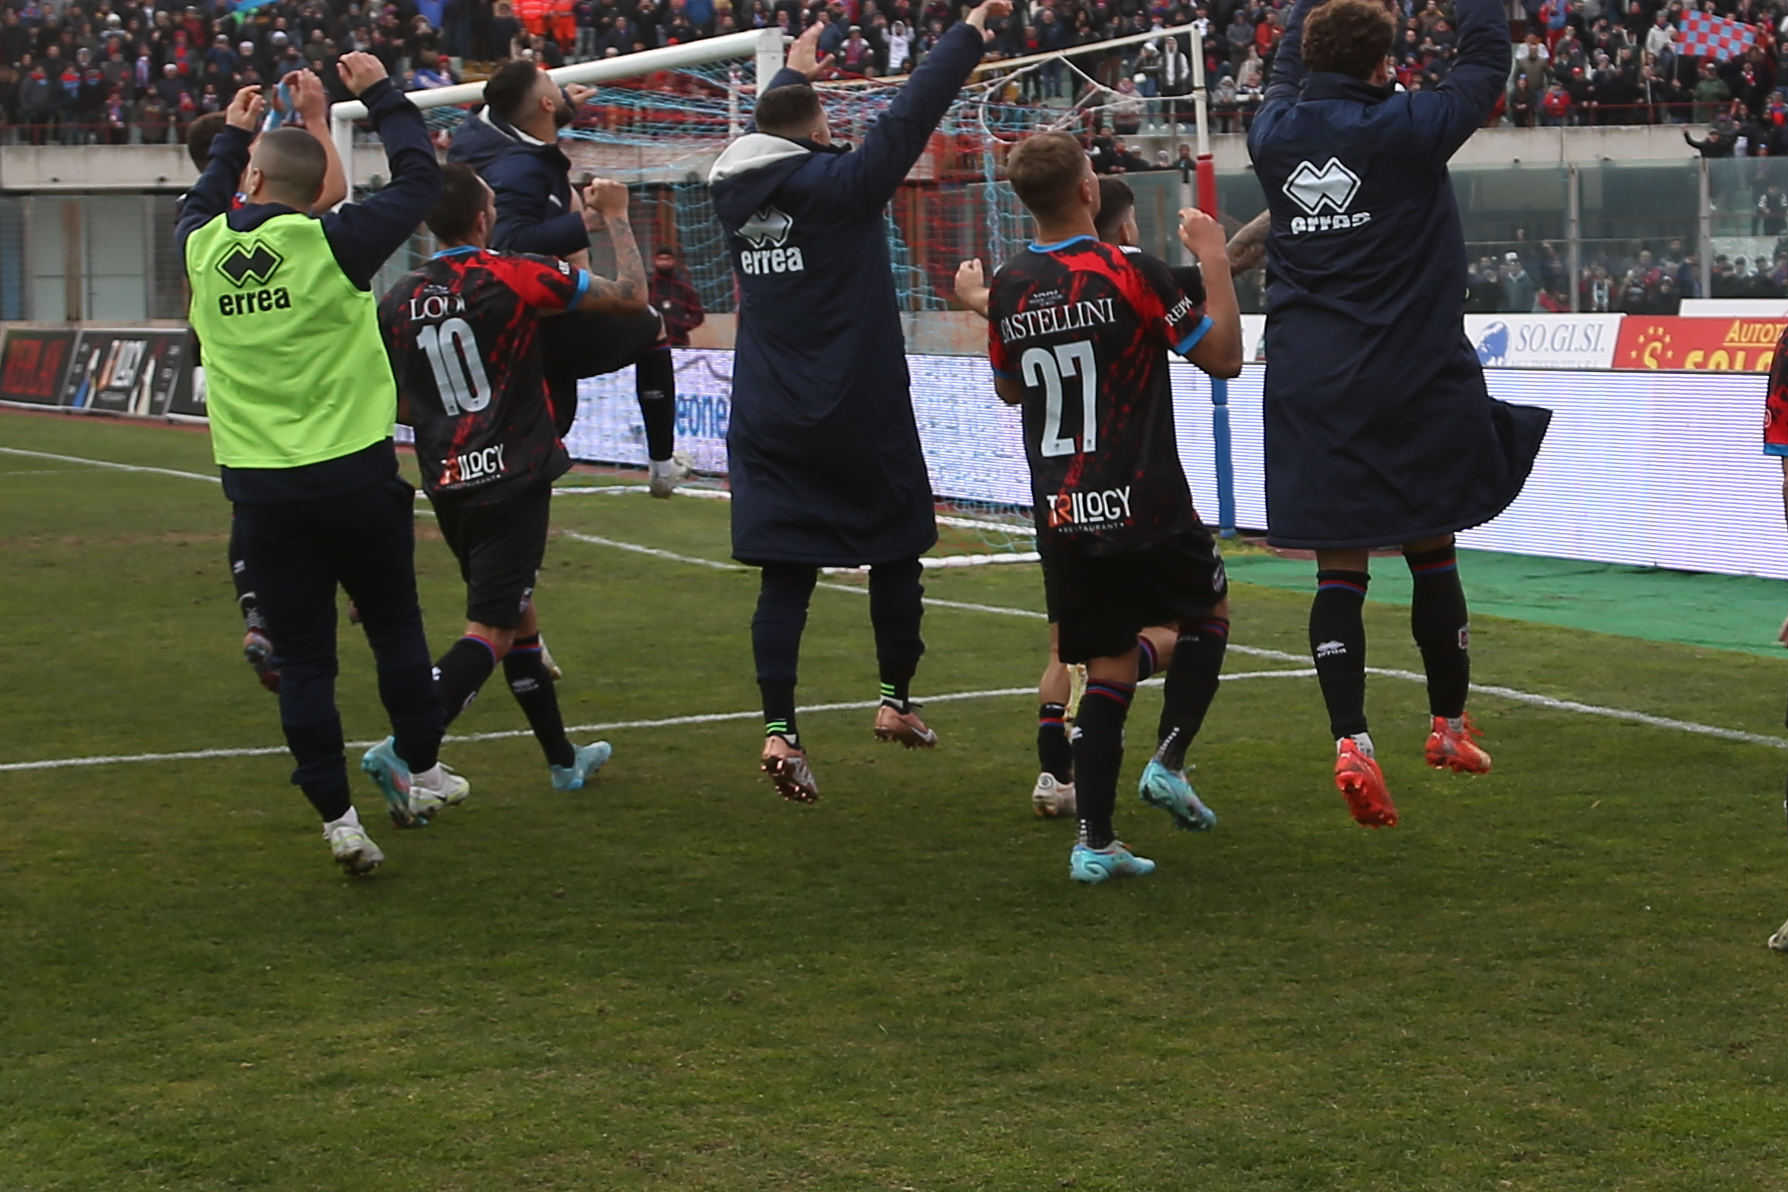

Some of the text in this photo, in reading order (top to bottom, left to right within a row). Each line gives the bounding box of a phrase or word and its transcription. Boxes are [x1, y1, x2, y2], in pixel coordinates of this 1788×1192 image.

[741, 247, 804, 275] errea
[218, 287, 292, 317] errea
[1515, 320, 1606, 352] SO.GI.SI.
[416, 318, 492, 417] 10
[1021, 340, 1097, 457] 27
[1047, 486, 1132, 526] TRILOGY
